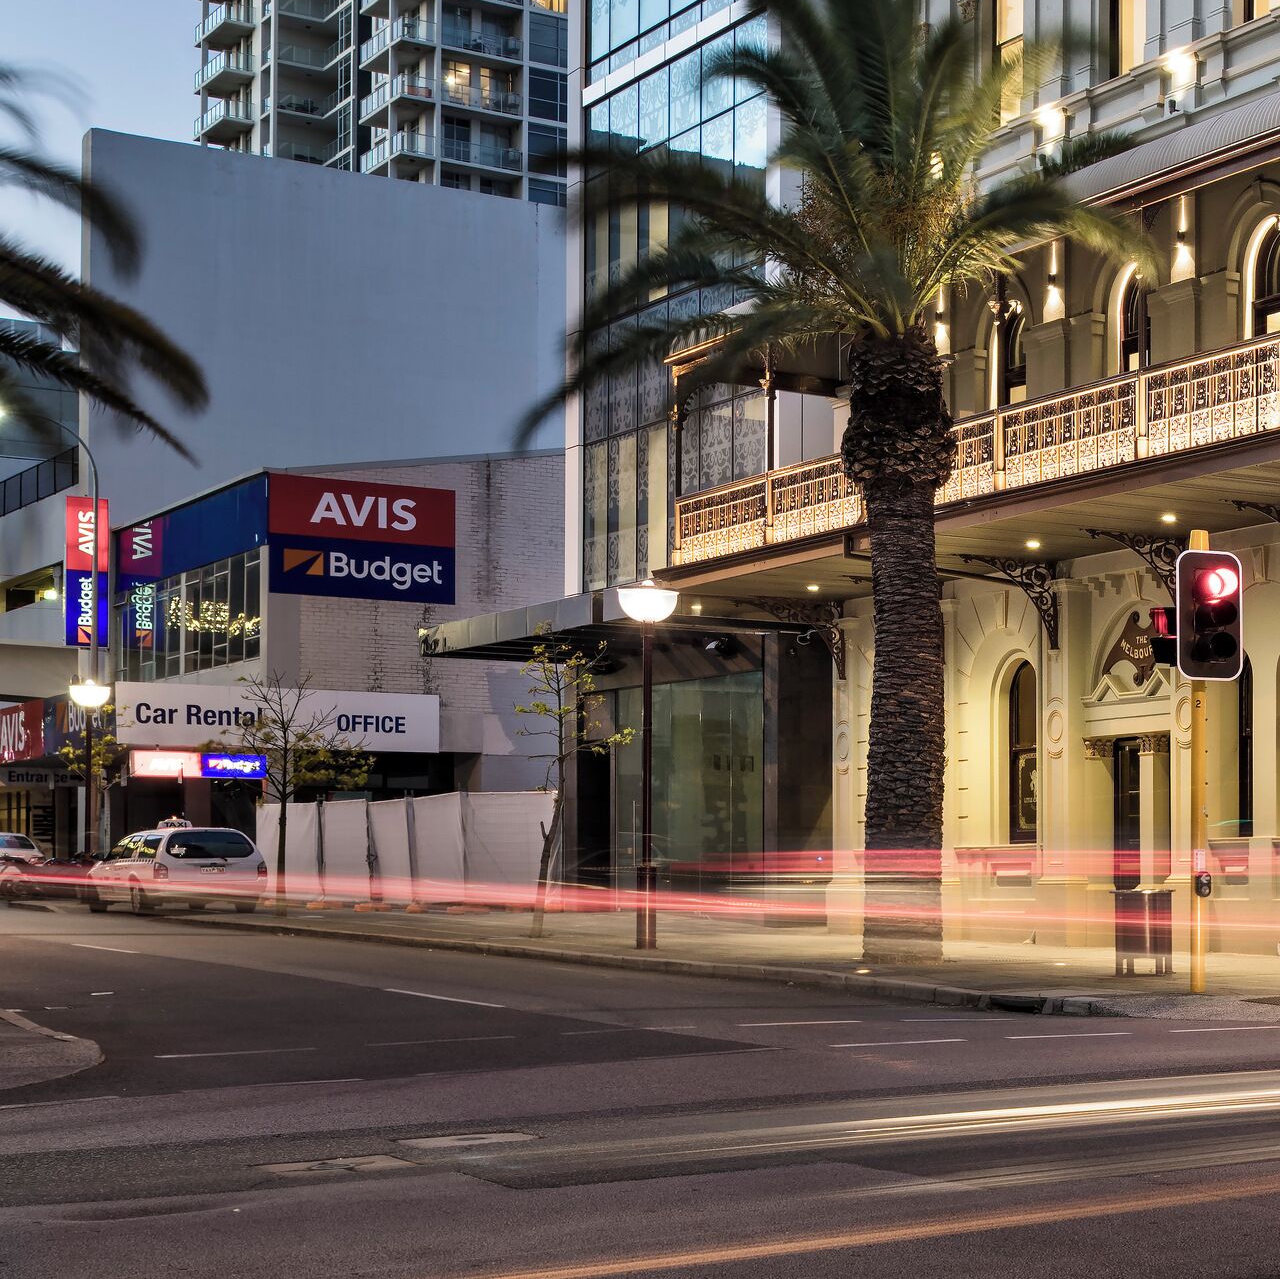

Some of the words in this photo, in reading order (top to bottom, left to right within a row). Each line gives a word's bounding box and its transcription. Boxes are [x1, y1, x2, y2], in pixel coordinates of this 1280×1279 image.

[309, 492, 417, 531] AVIS
[78, 510, 95, 557] AVIS
[330, 552, 443, 590] Budget
[1120, 639, 1153, 659] MELBOUR
[1136, 635, 1148, 644] THE
[135, 702, 178, 725] Car
[186, 703, 262, 727] Rental
[1195, 699, 1201, 708] 2
[0, 711, 25, 754] AVIS
[337, 714, 406, 734] OFFICE
